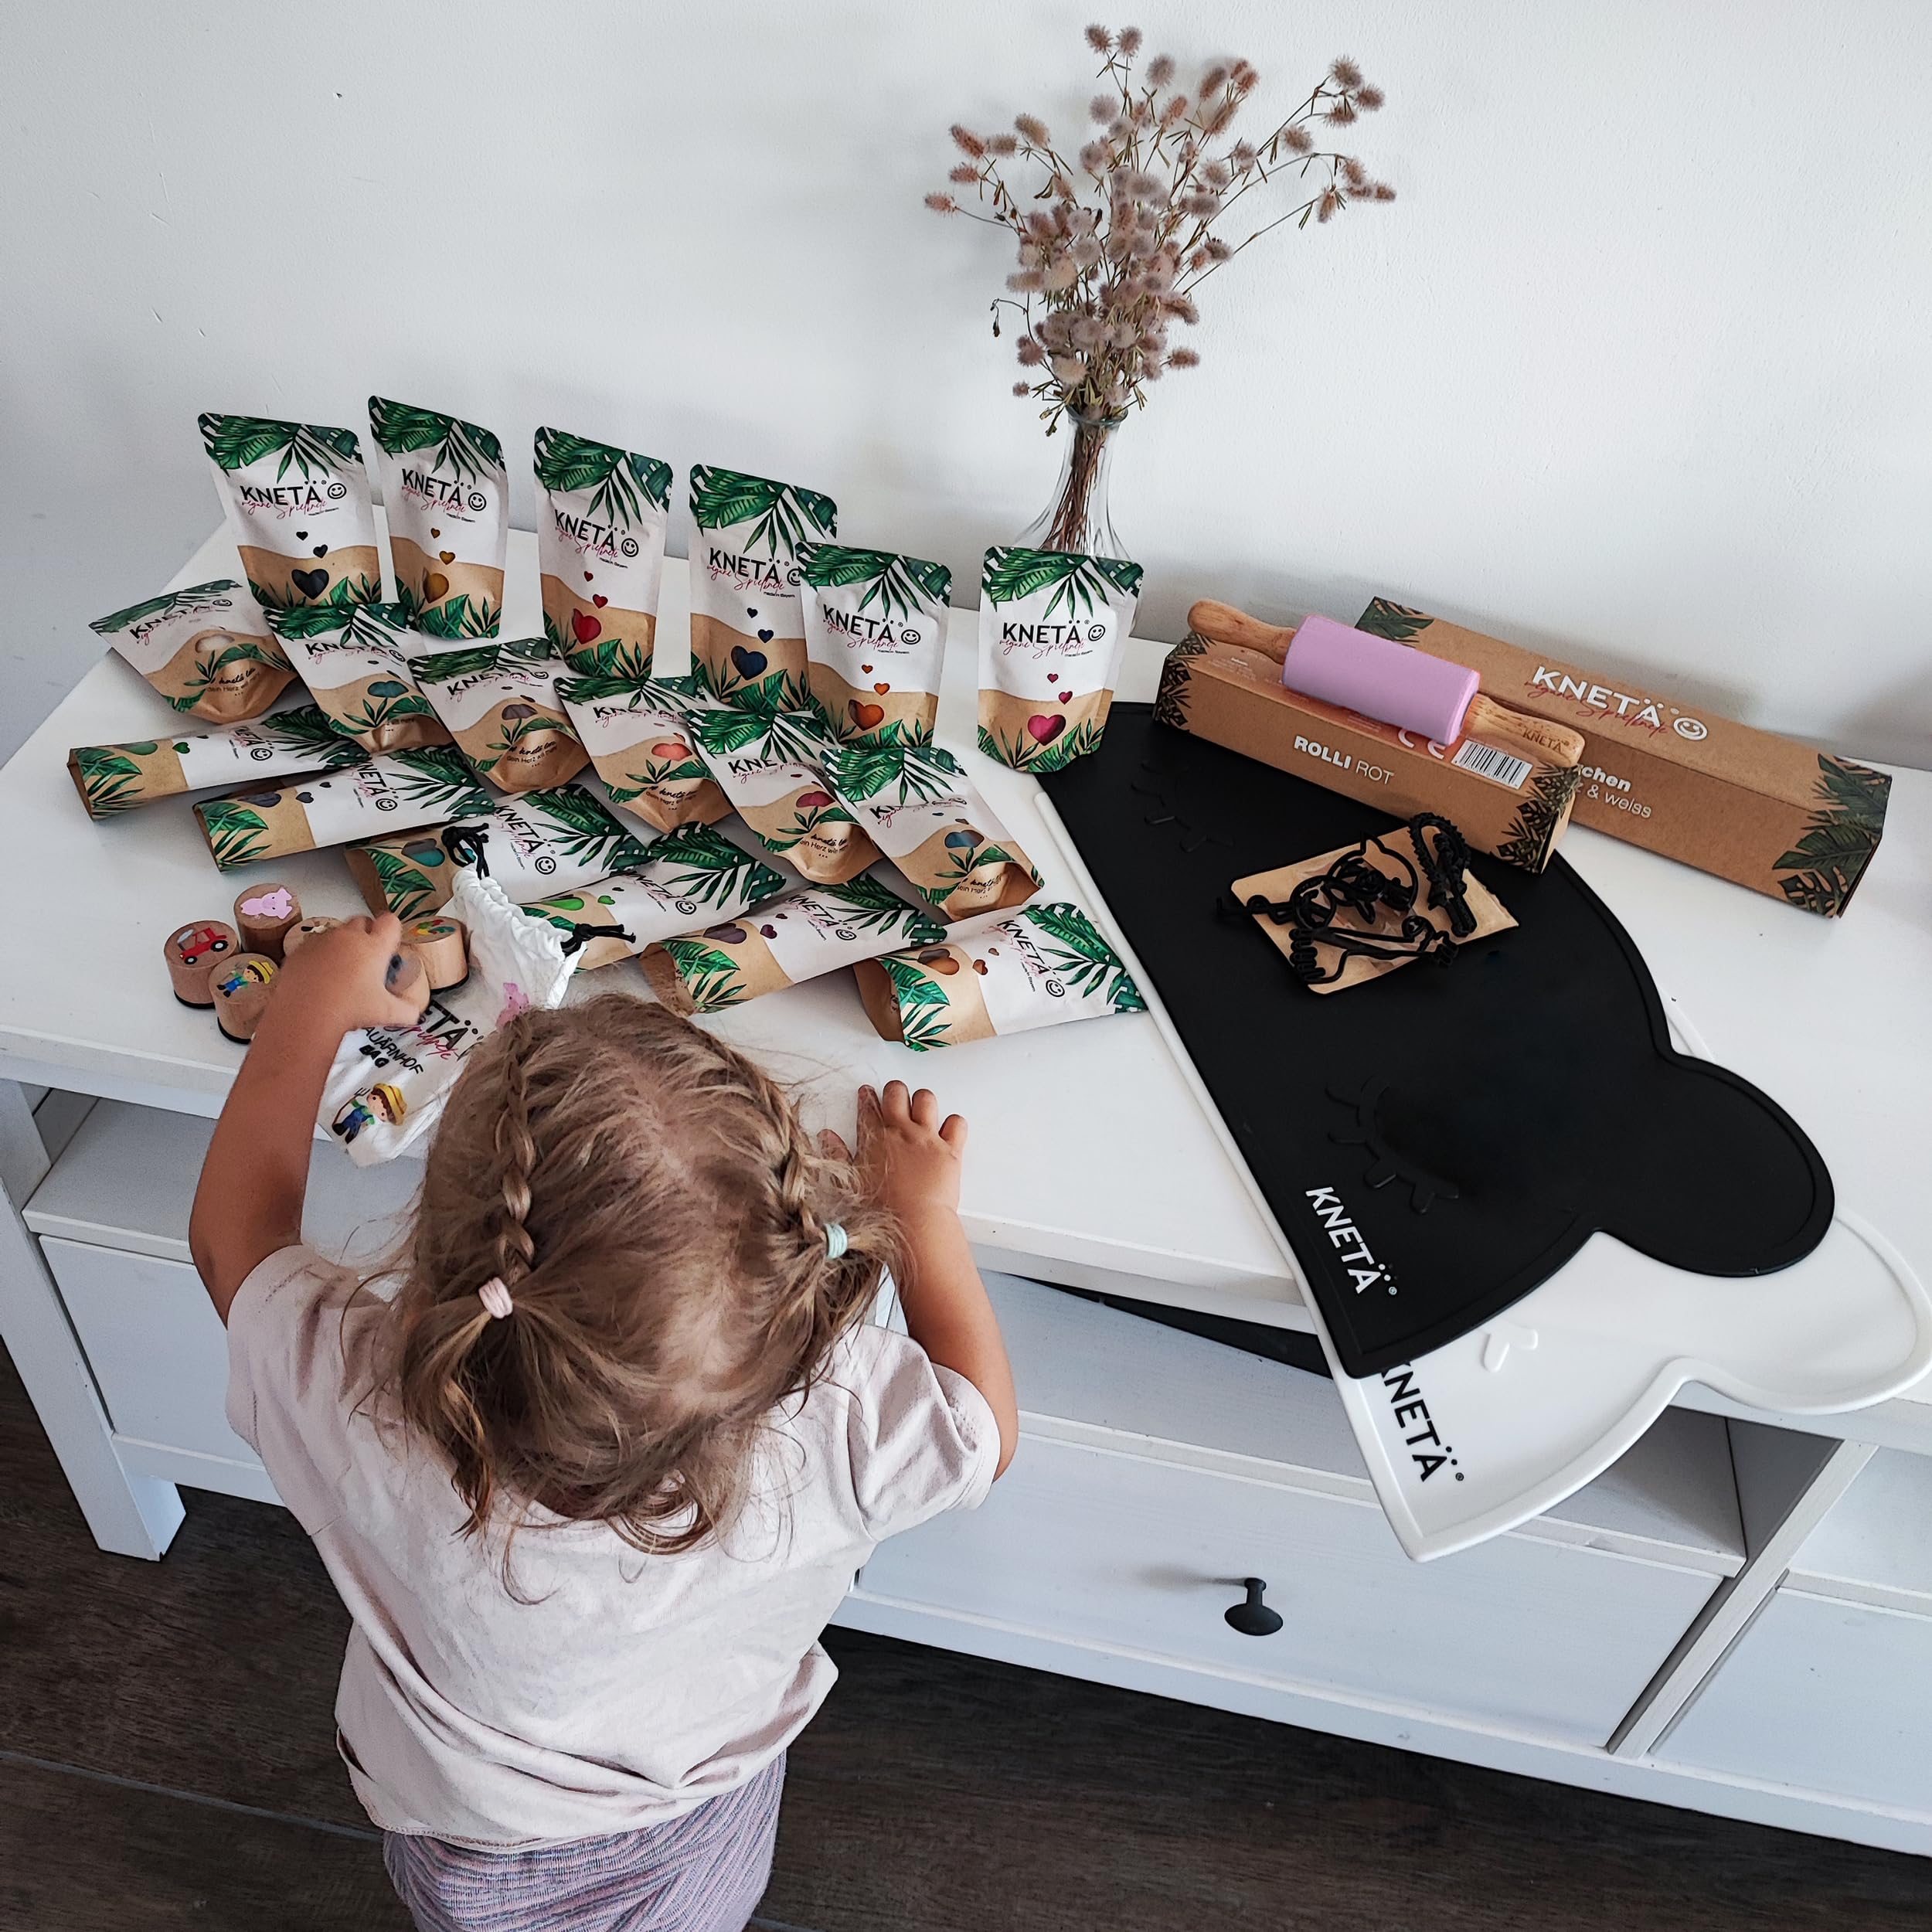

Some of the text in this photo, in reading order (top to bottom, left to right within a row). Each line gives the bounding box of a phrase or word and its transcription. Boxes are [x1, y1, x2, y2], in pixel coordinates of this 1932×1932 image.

[1294, 735, 1395, 785] ROLLI ROT
[1581, 766, 1631, 792] chen
[1587, 784, 1599, 799] &
[1605, 791, 1651, 818] weiss
[359, 1044, 390, 1069] BAG
[365, 1027, 424, 1075] AUÄRNHOF
